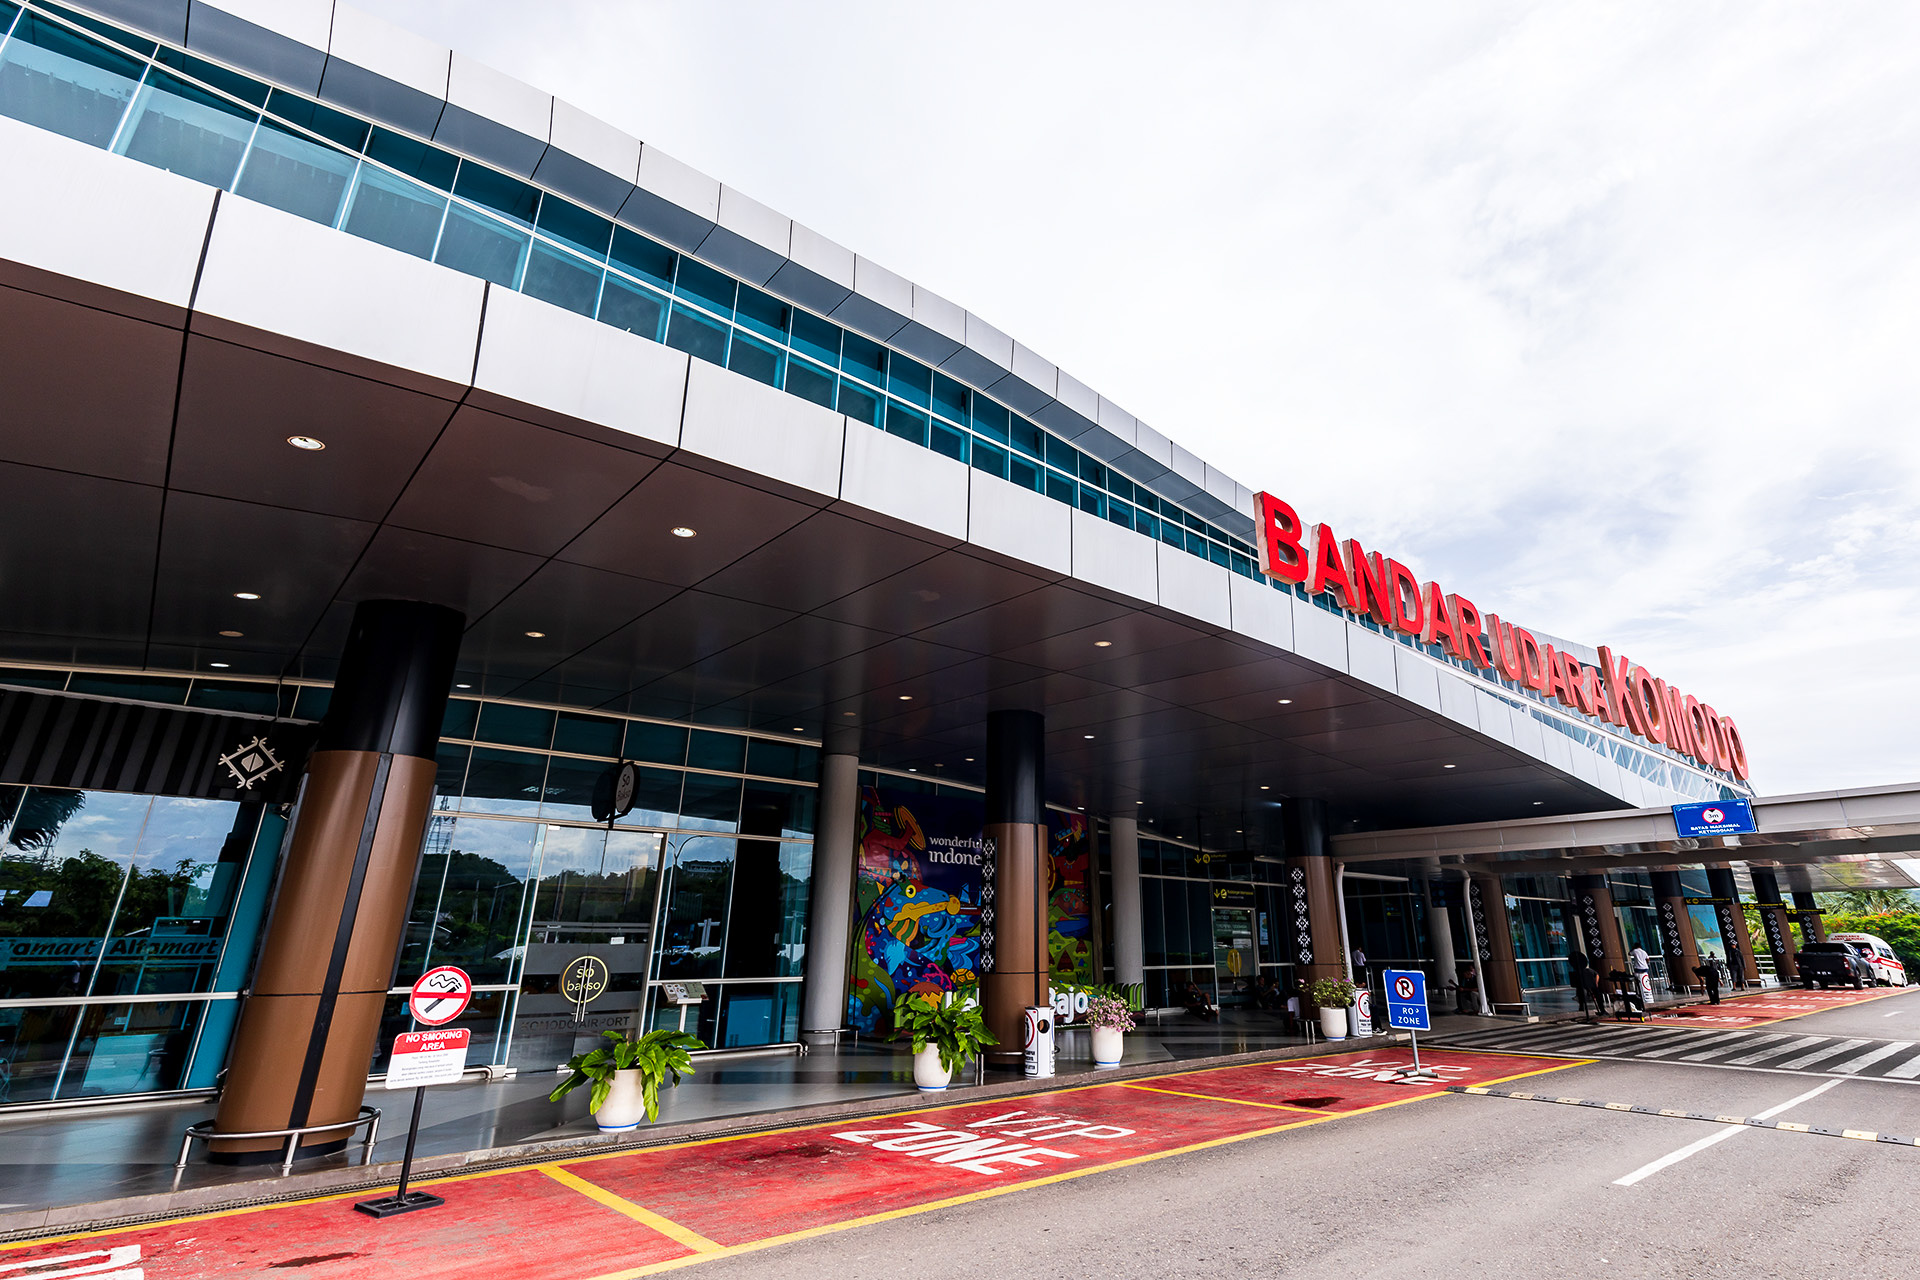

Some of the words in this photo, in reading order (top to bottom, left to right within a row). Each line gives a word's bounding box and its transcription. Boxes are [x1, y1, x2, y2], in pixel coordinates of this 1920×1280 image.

[1253, 491, 1491, 670] BANDAR
[1485, 614, 1613, 723] UDARA
[1597, 646, 1749, 781] KOMODO
[929, 836, 982, 849] wonderful
[928, 848, 982, 866] indone
[110, 938, 219, 955] Alfamart
[1398, 1016, 1421, 1025] ZONE
[406, 1034, 420, 1043] NO
[421, 1031, 463, 1042] SMOKING
[420, 1042, 445, 1051] AREA
[965, 1111, 1137, 1141] VIP
[830, 1121, 1081, 1175] ZONE
